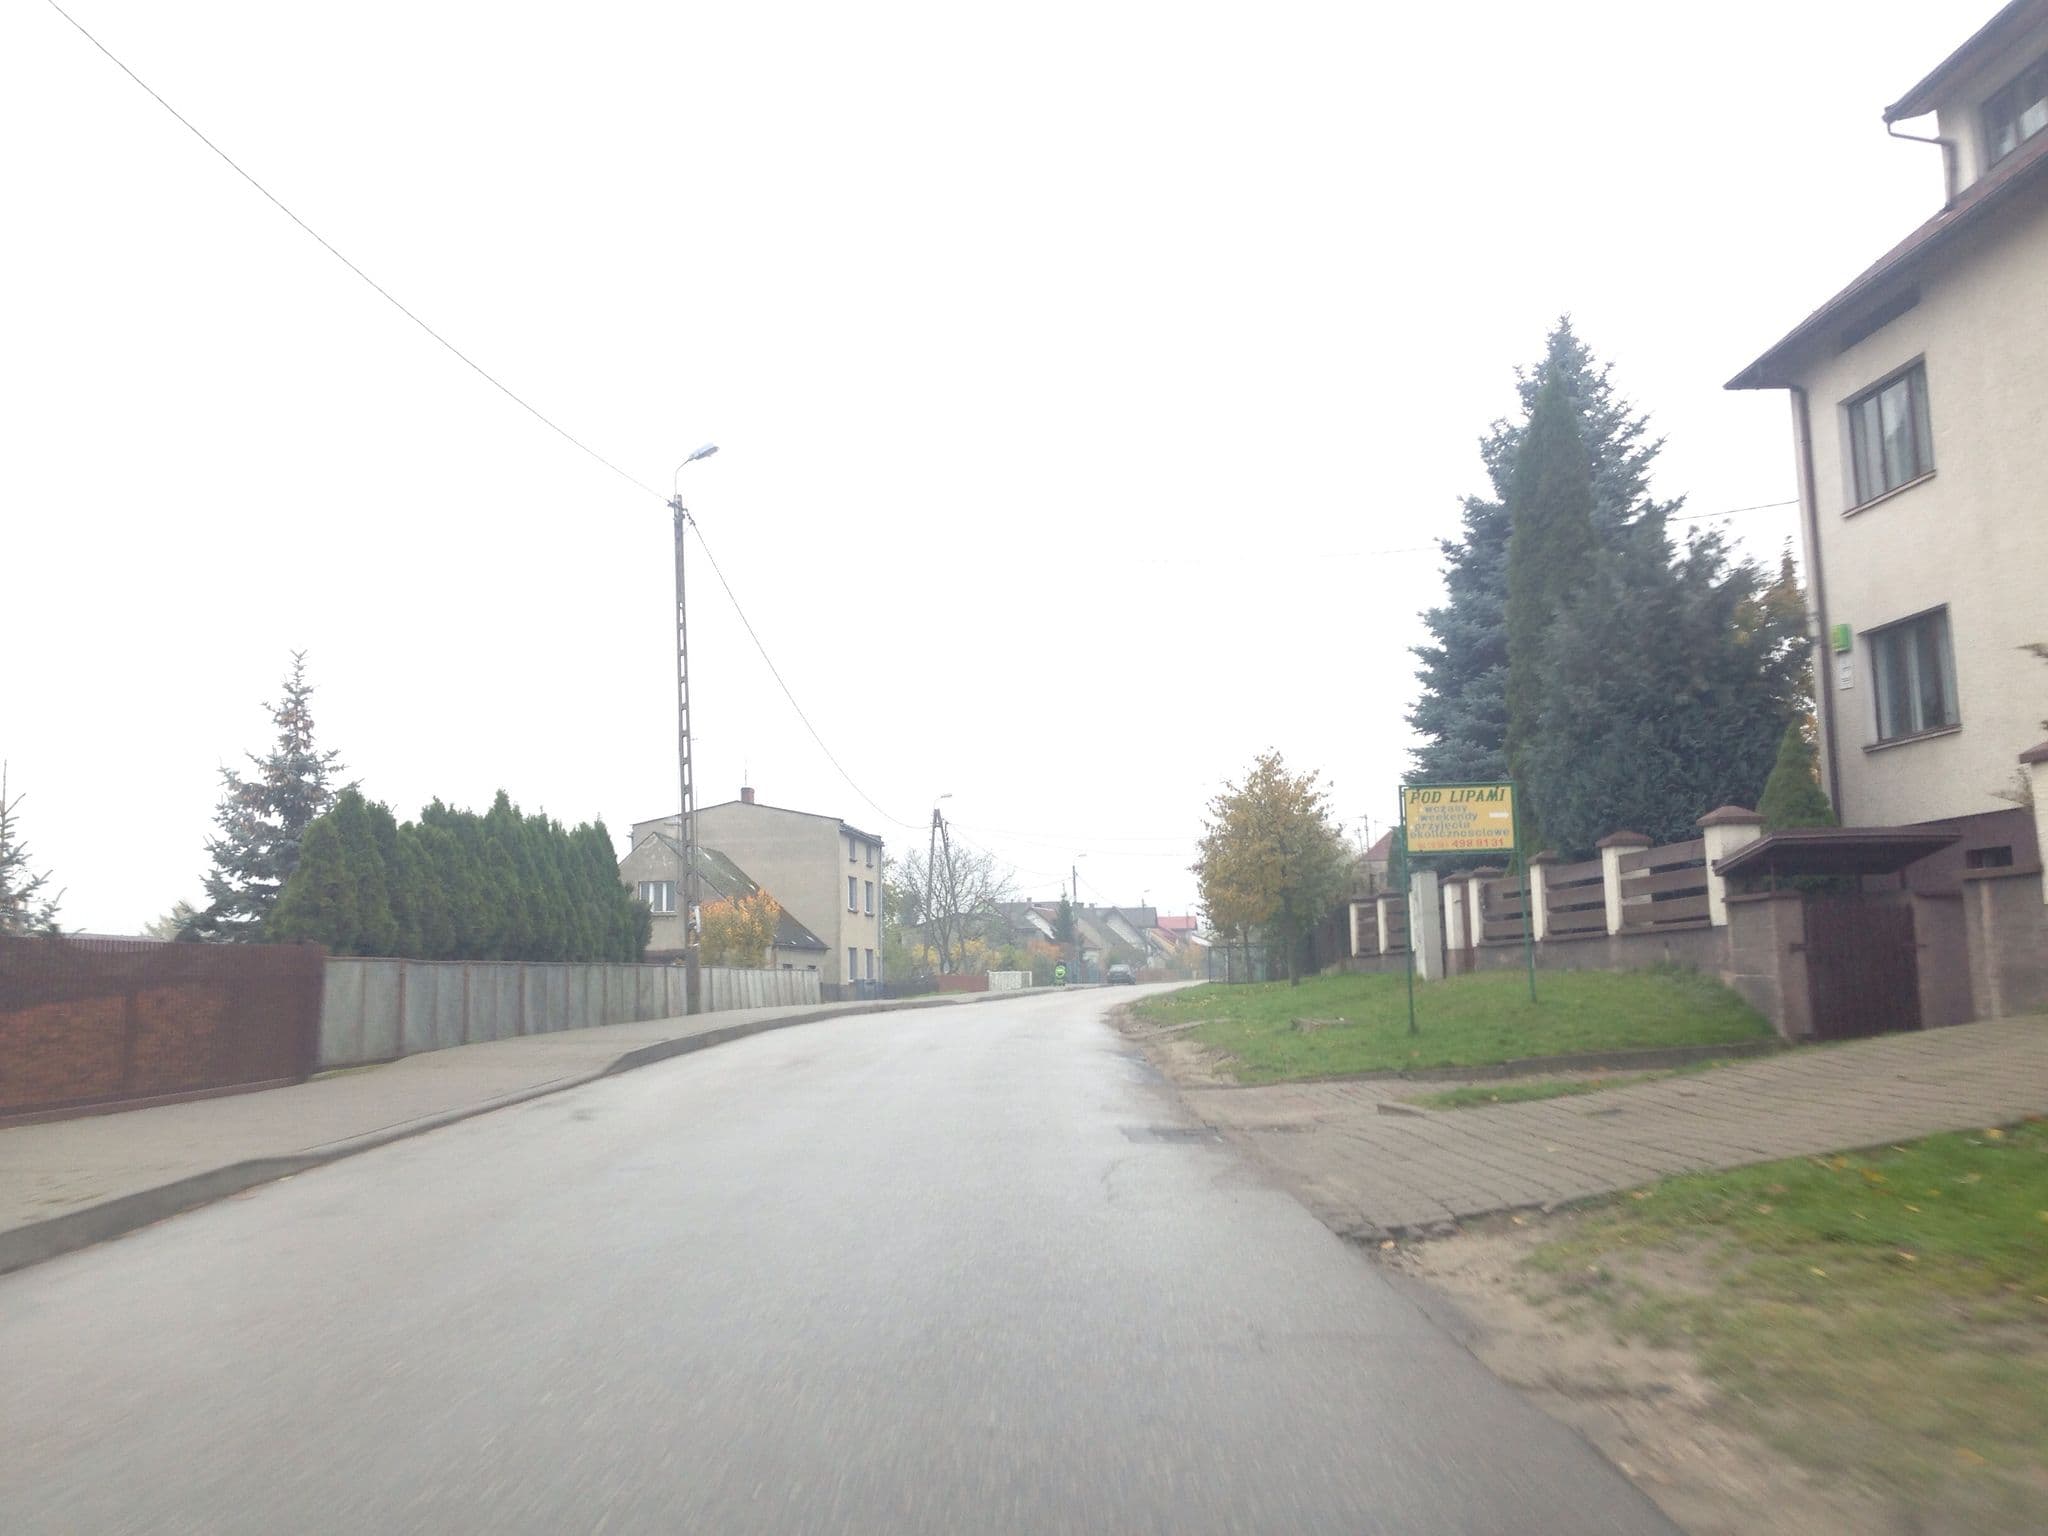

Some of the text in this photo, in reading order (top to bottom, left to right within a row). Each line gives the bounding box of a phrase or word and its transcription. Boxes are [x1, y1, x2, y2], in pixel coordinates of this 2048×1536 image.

[1409, 788, 1505, 804] POD LIPAMI
[1419, 812, 1478, 822] weekendy
